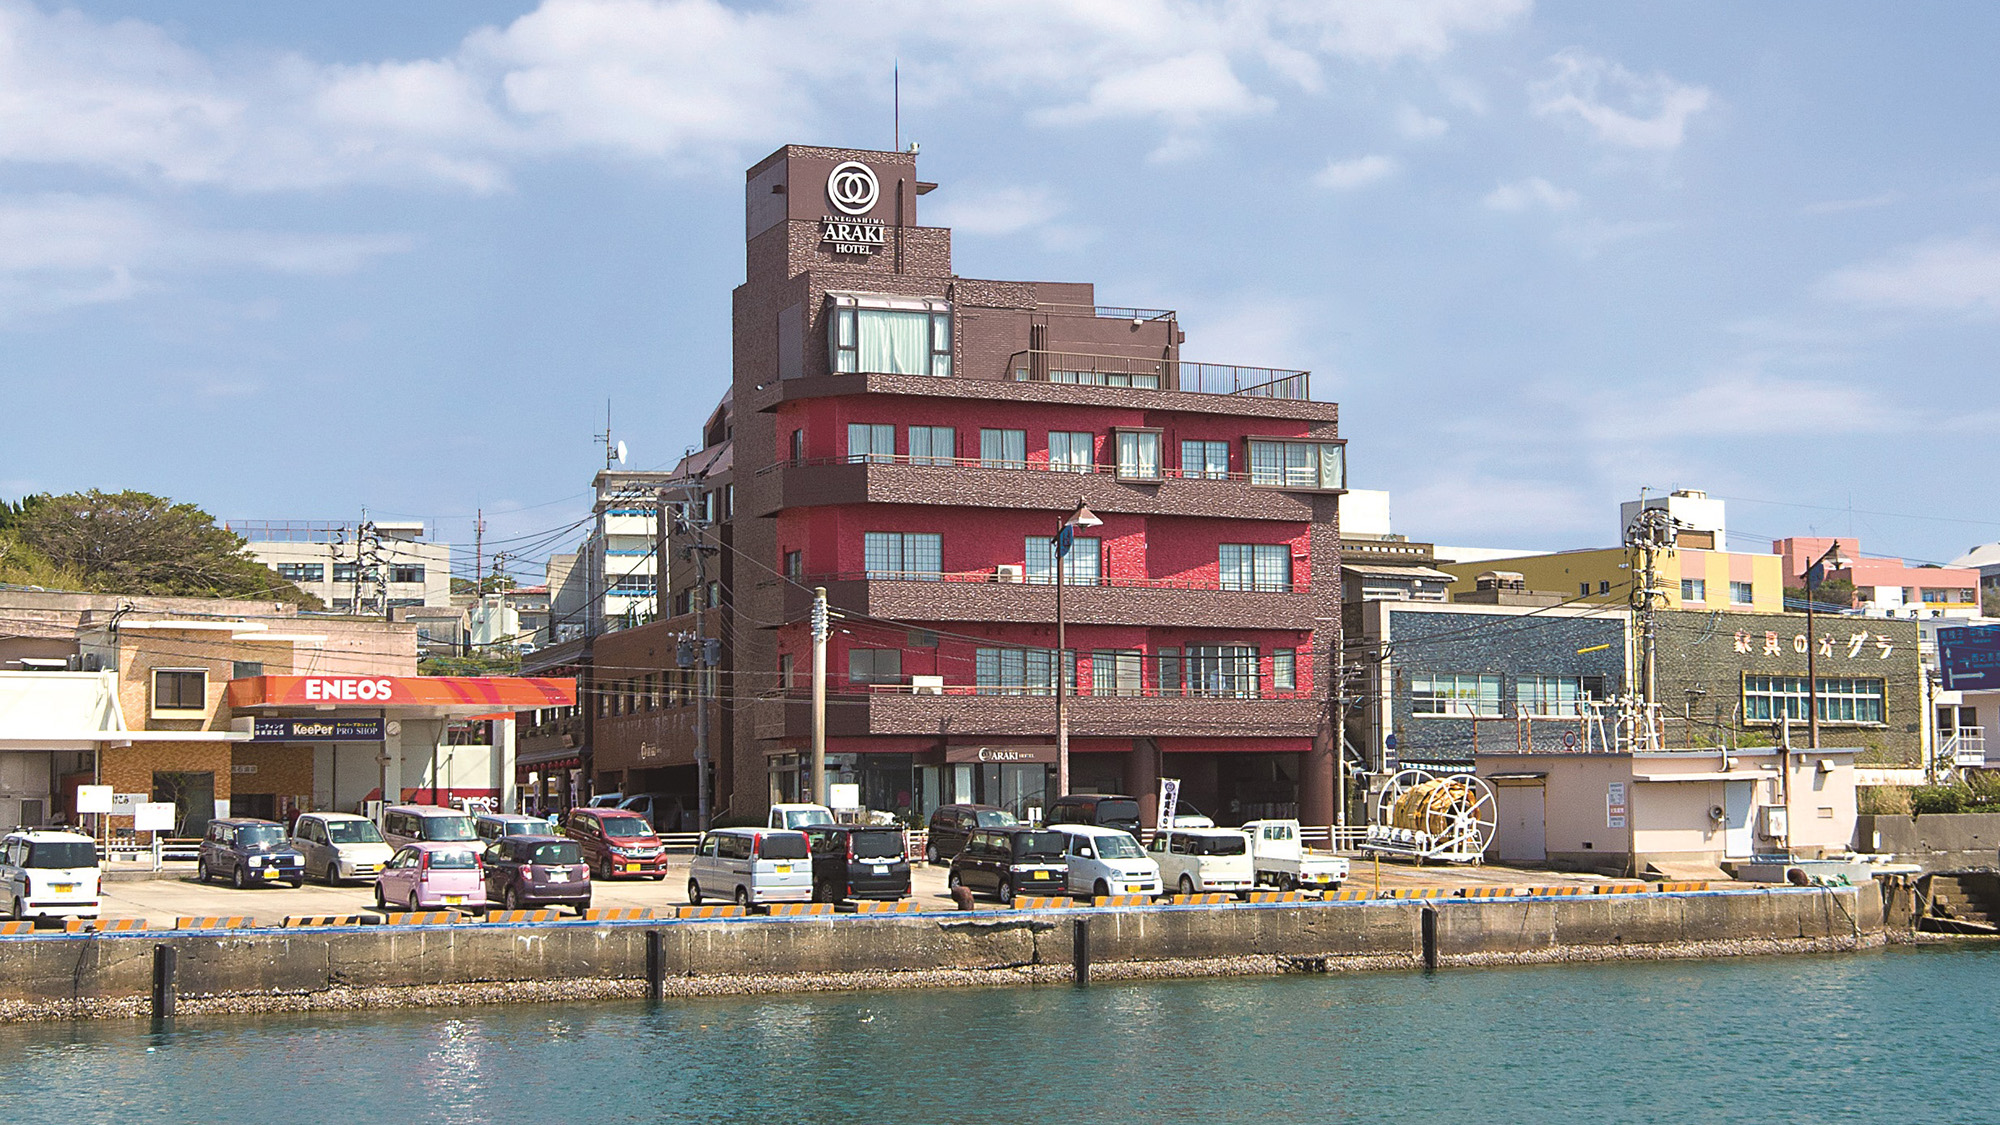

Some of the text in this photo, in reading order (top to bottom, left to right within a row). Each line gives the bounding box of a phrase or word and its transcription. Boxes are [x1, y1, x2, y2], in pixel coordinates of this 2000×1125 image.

[823, 215, 885, 224] TANEGASHIMA
[823, 223, 885, 242] ARAKI
[836, 244, 873, 254] HOTEL
[1733, 628, 1894, 660] 家具のオグラ
[305, 679, 392, 700] ENEOS
[293, 724, 333, 736] KeePer
[336, 727, 378, 736] PRO SHOP
[991, 751, 1019, 760] ARAKI
